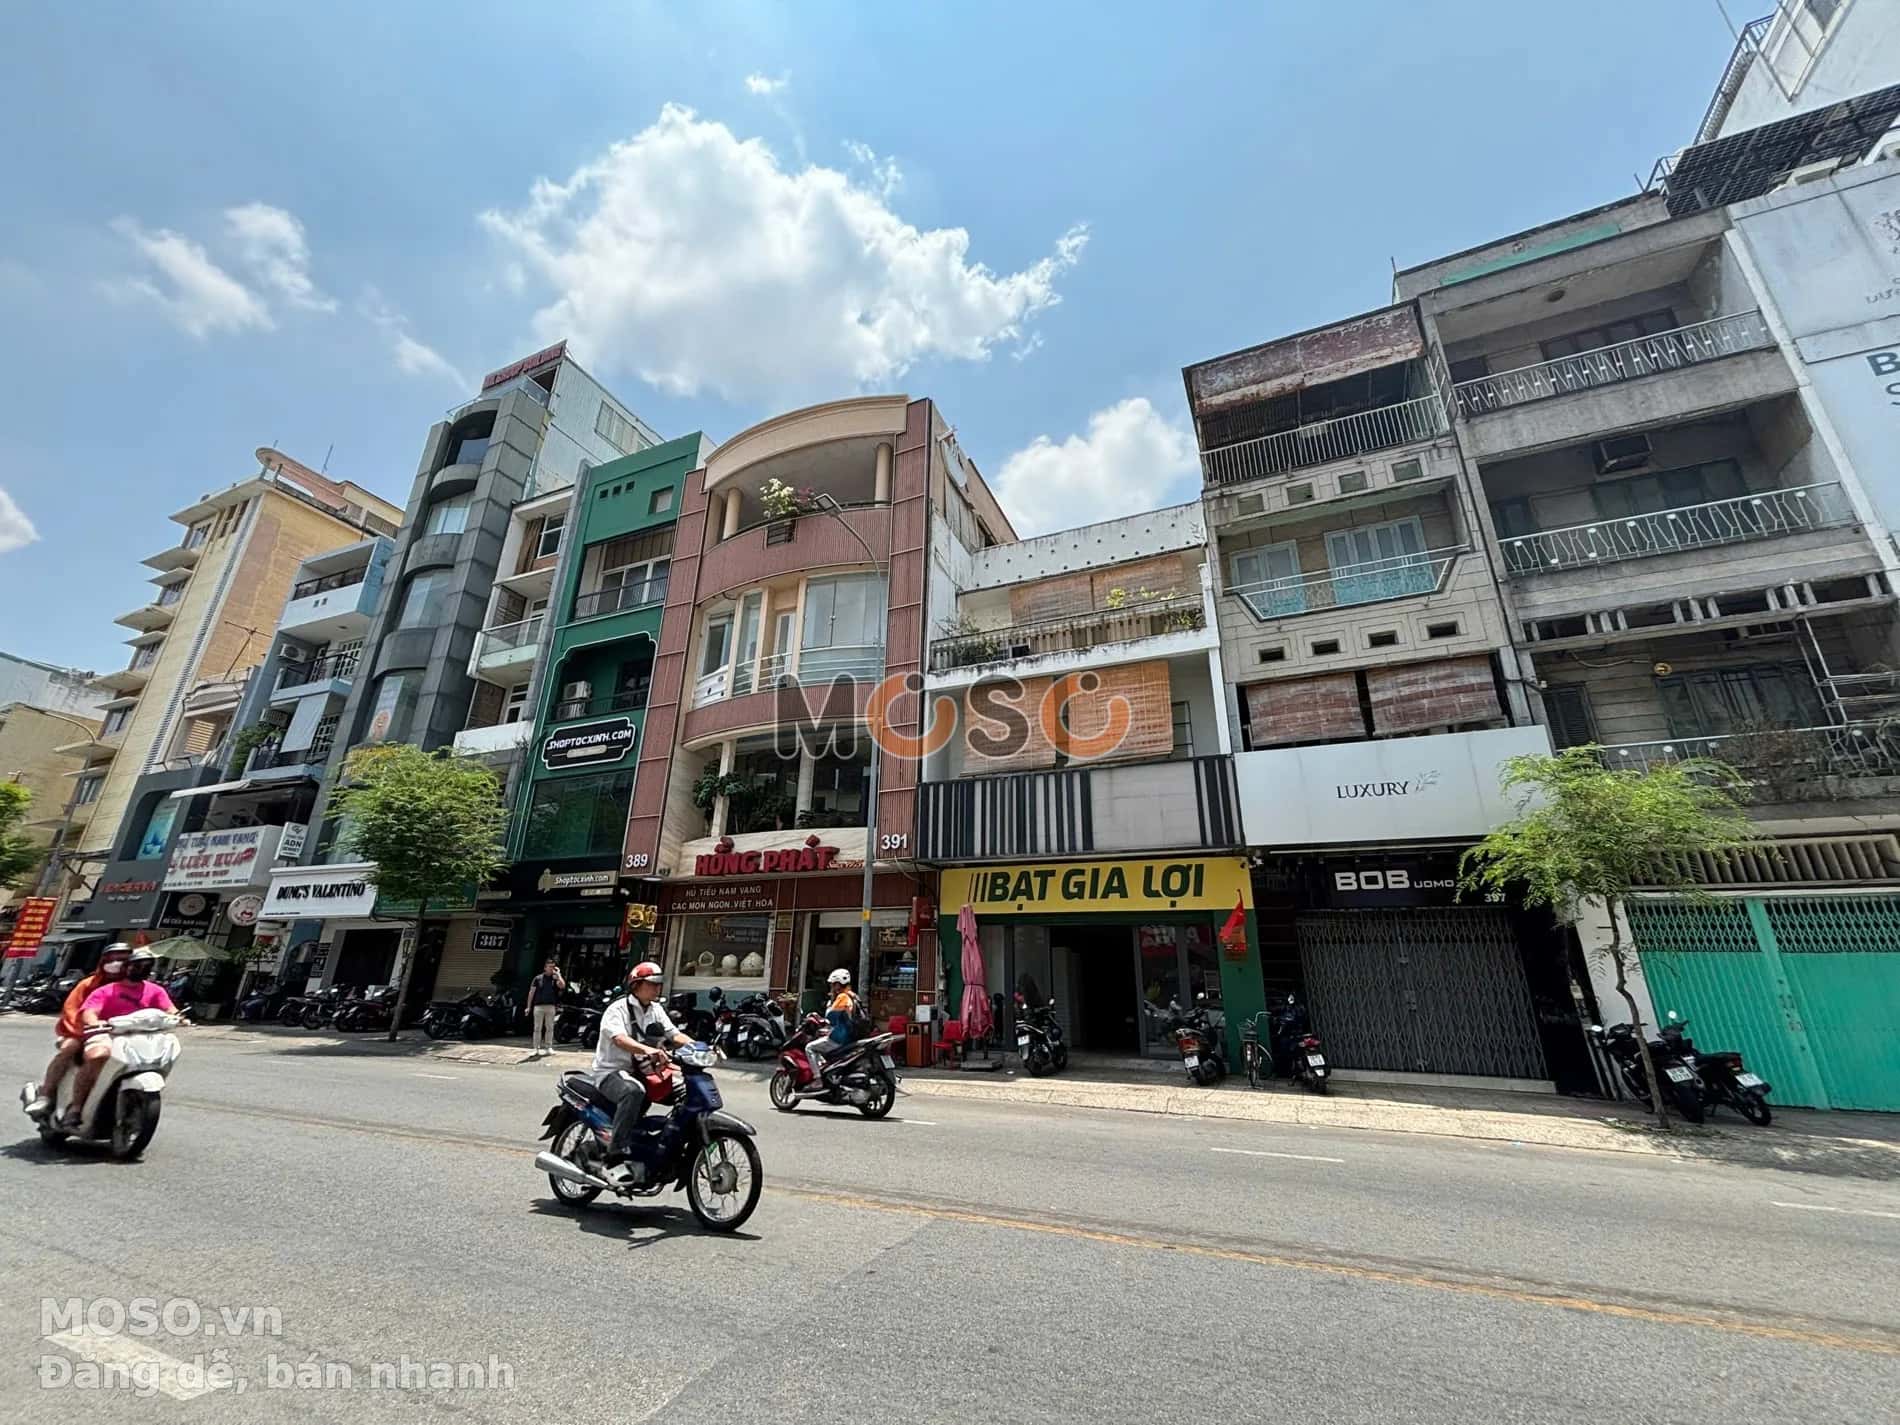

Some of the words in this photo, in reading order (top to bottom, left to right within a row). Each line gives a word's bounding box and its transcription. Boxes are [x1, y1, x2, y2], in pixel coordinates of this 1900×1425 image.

[547, 729, 632, 750] SHOPTOCXINH.COM
[1336, 781, 1409, 799] LUXURY
[283, 839, 302, 849] ADN
[881, 834, 908, 849] 391
[626, 854, 648, 868] 389
[988, 869, 1056, 911] BẠT
[1061, 867, 1129, 900] GIA
[1143, 864, 1204, 908] LỢI
[1335, 870, 1410, 891] BOB
[1414, 880, 1454, 889] UOMO
[312, 882, 366, 898] VALENTINO
[719, 887, 737, 896] NAM
[740, 885, 761, 895] VANG
[480, 934, 505, 947] 387
